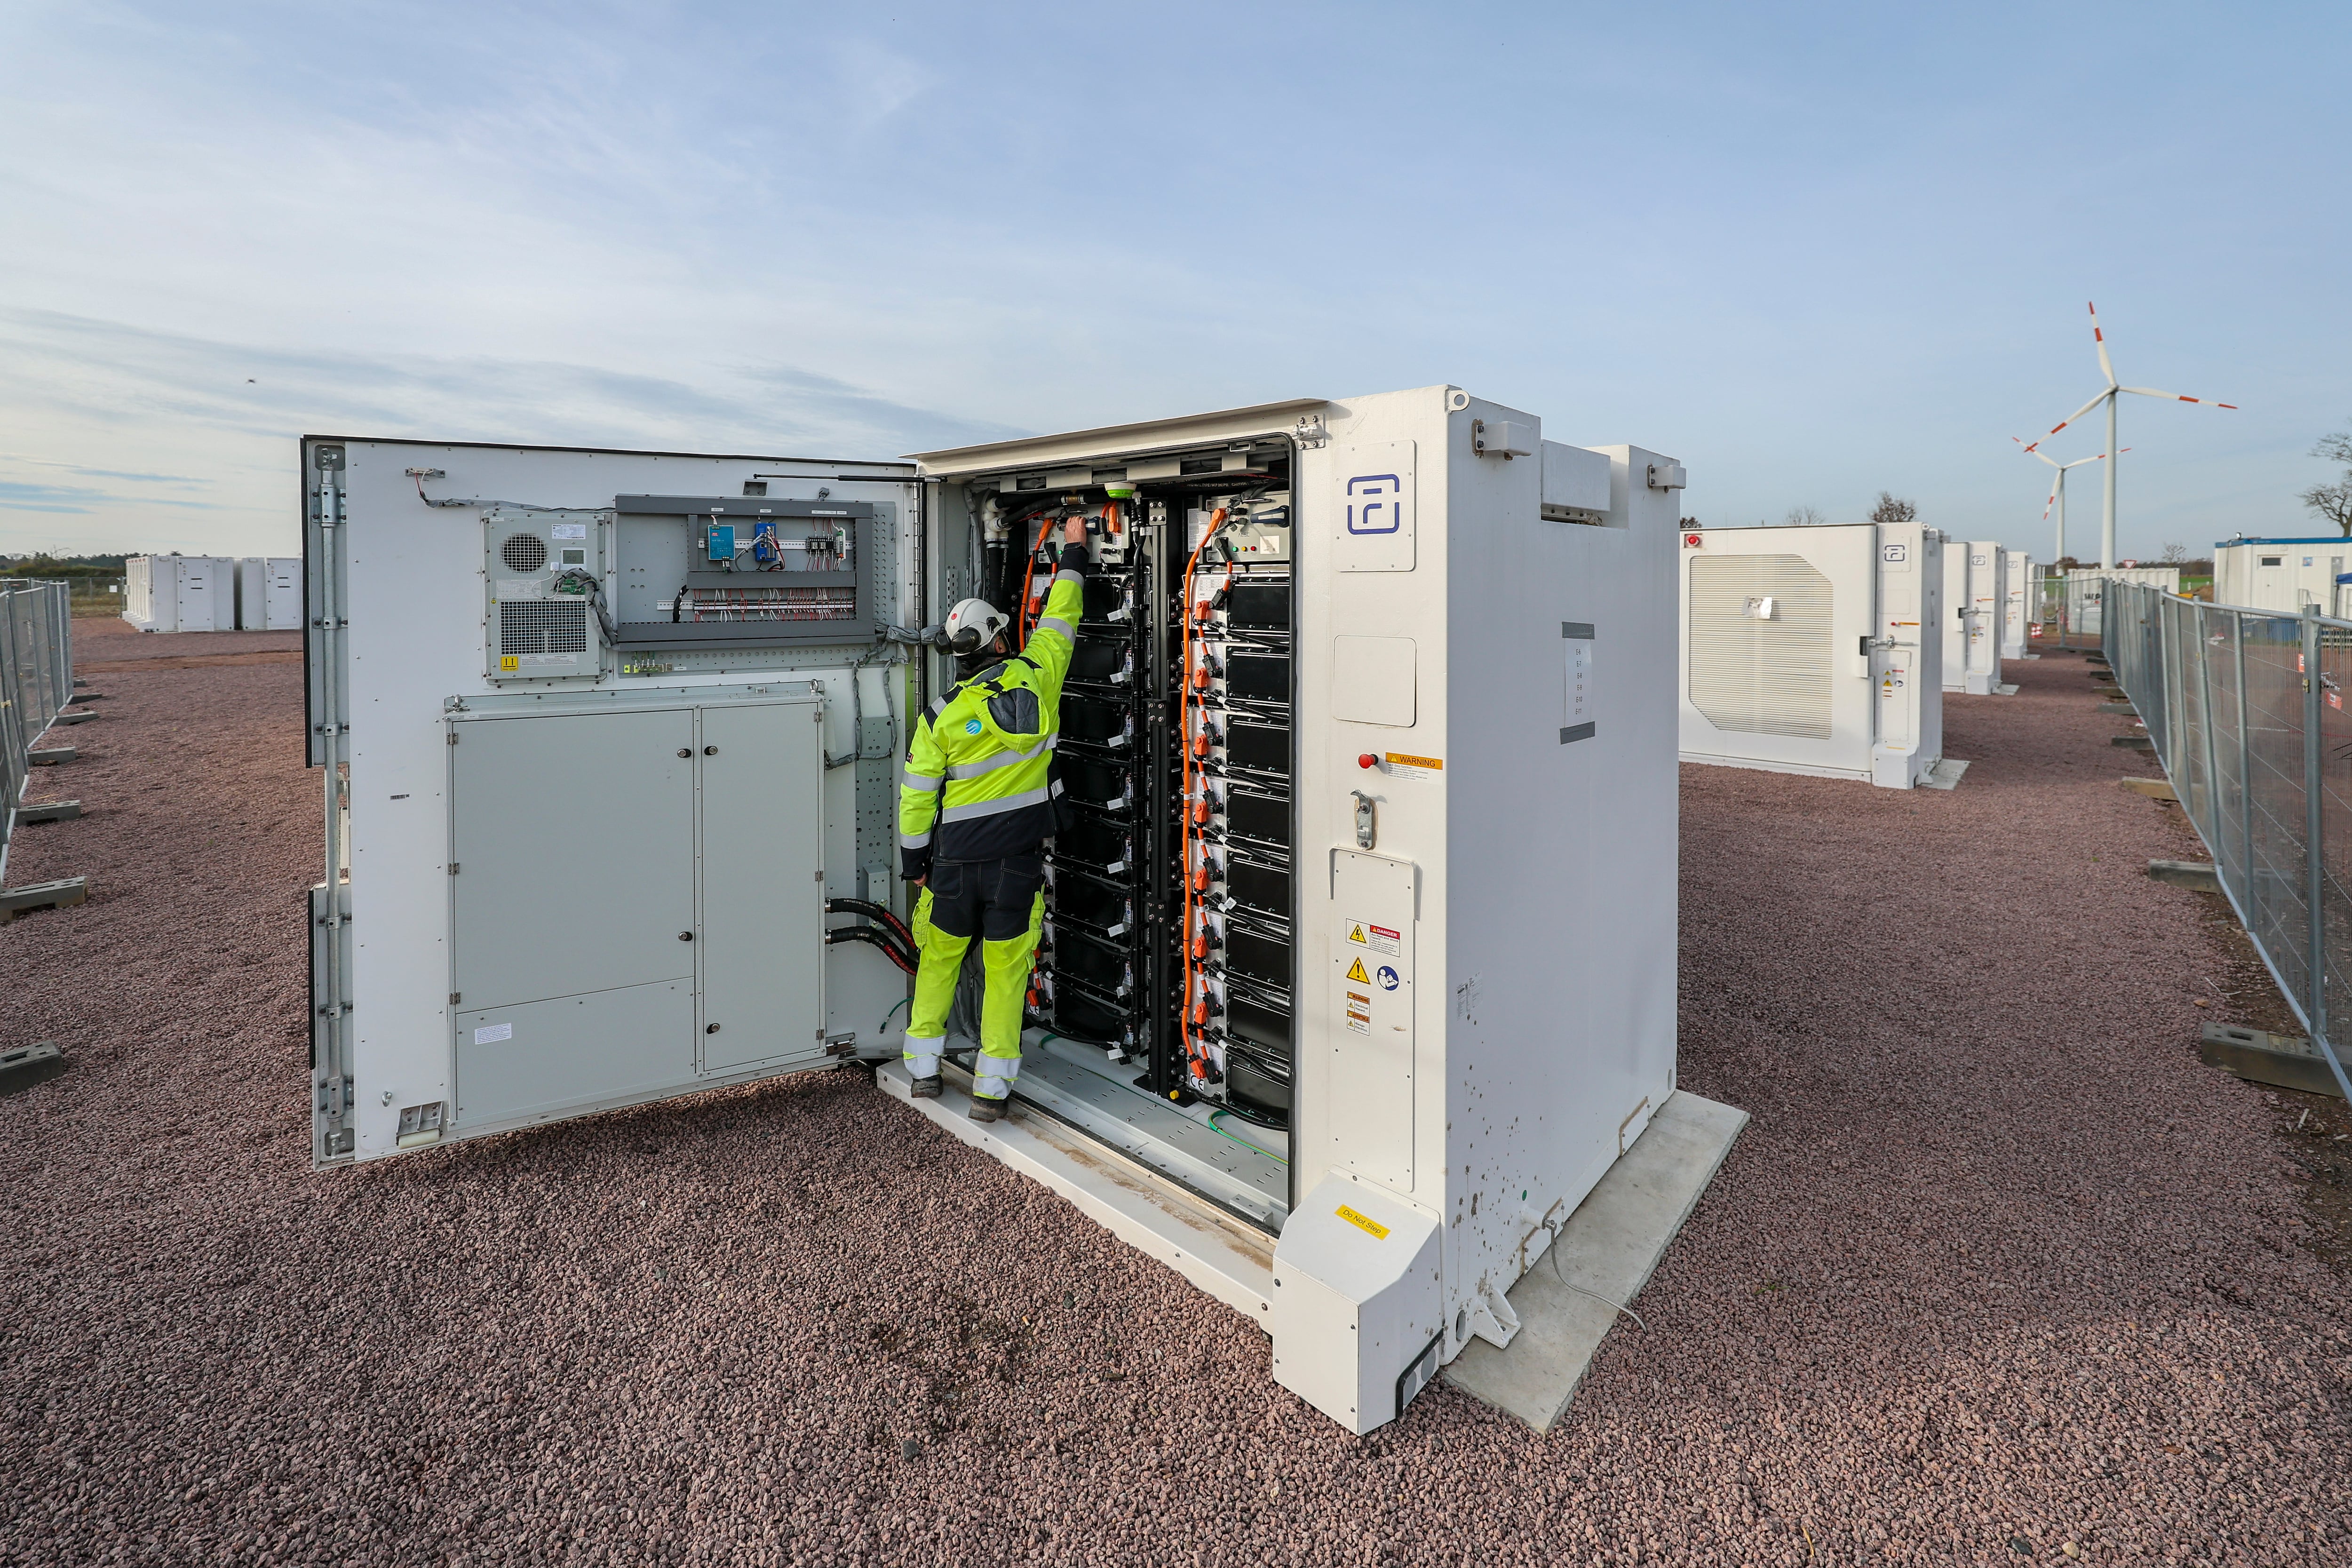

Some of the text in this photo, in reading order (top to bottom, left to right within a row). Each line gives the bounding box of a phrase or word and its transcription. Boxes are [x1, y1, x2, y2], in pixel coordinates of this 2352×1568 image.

[1400, 756, 1435, 767] WARNING
[1377, 929, 1397, 937] DANGER
[1353, 994, 1368, 1003] WARNING
[1353, 1216, 1366, 1225] Not
[1366, 1223, 1381, 1234] Step
